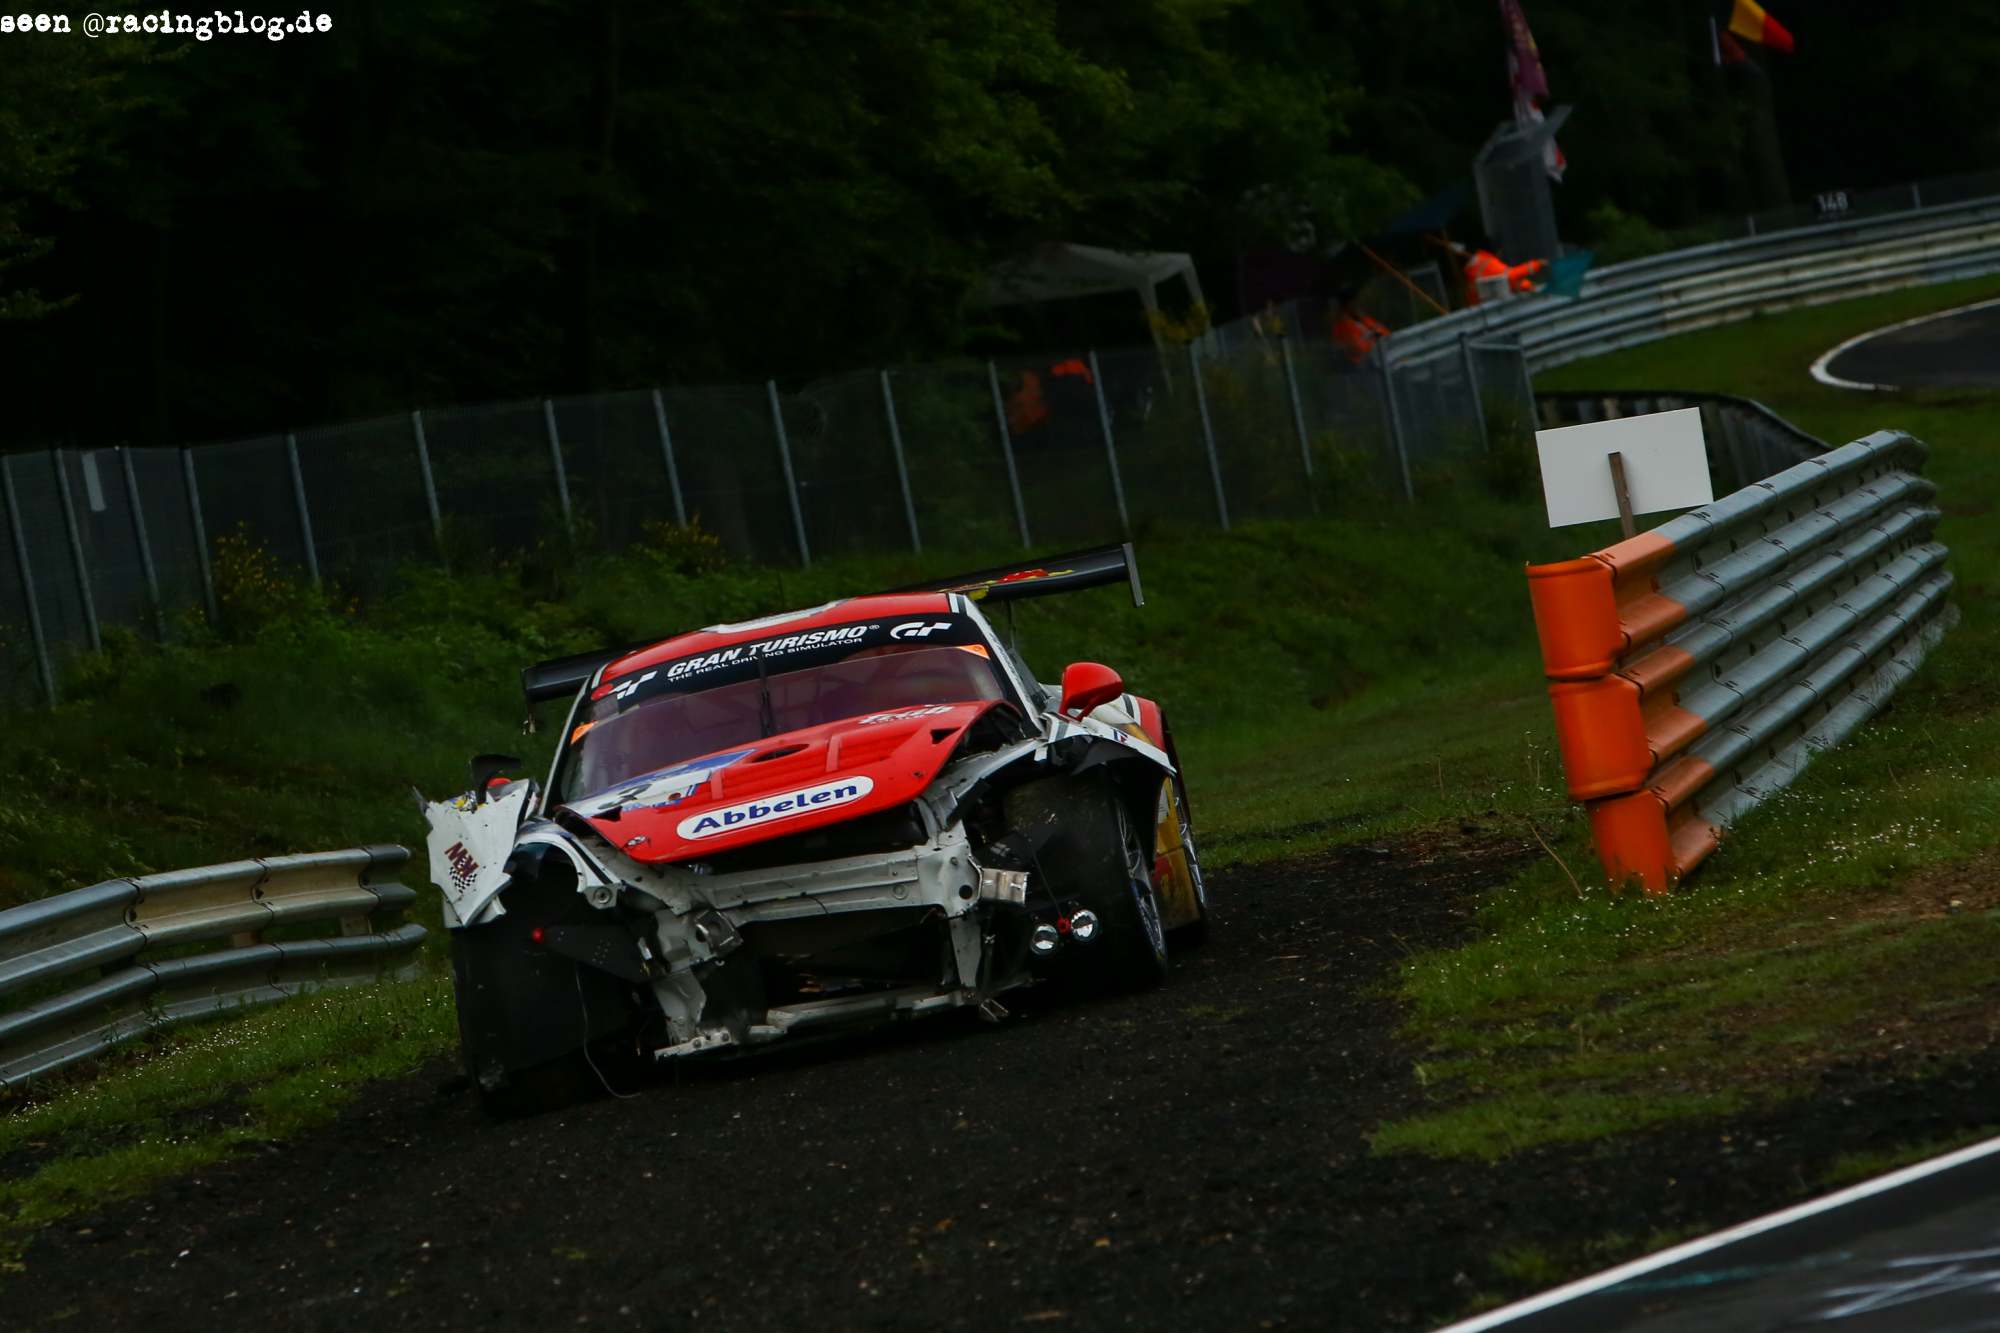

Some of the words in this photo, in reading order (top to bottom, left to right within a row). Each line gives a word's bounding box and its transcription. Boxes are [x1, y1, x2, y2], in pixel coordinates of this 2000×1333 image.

[666, 647, 743, 677] GRAN
[667, 671, 693, 683] THE
[695, 661, 729, 676] REAL
[787, 638, 863, 654] SIMULATOR
[692, 784, 858, 834] Abbelen
